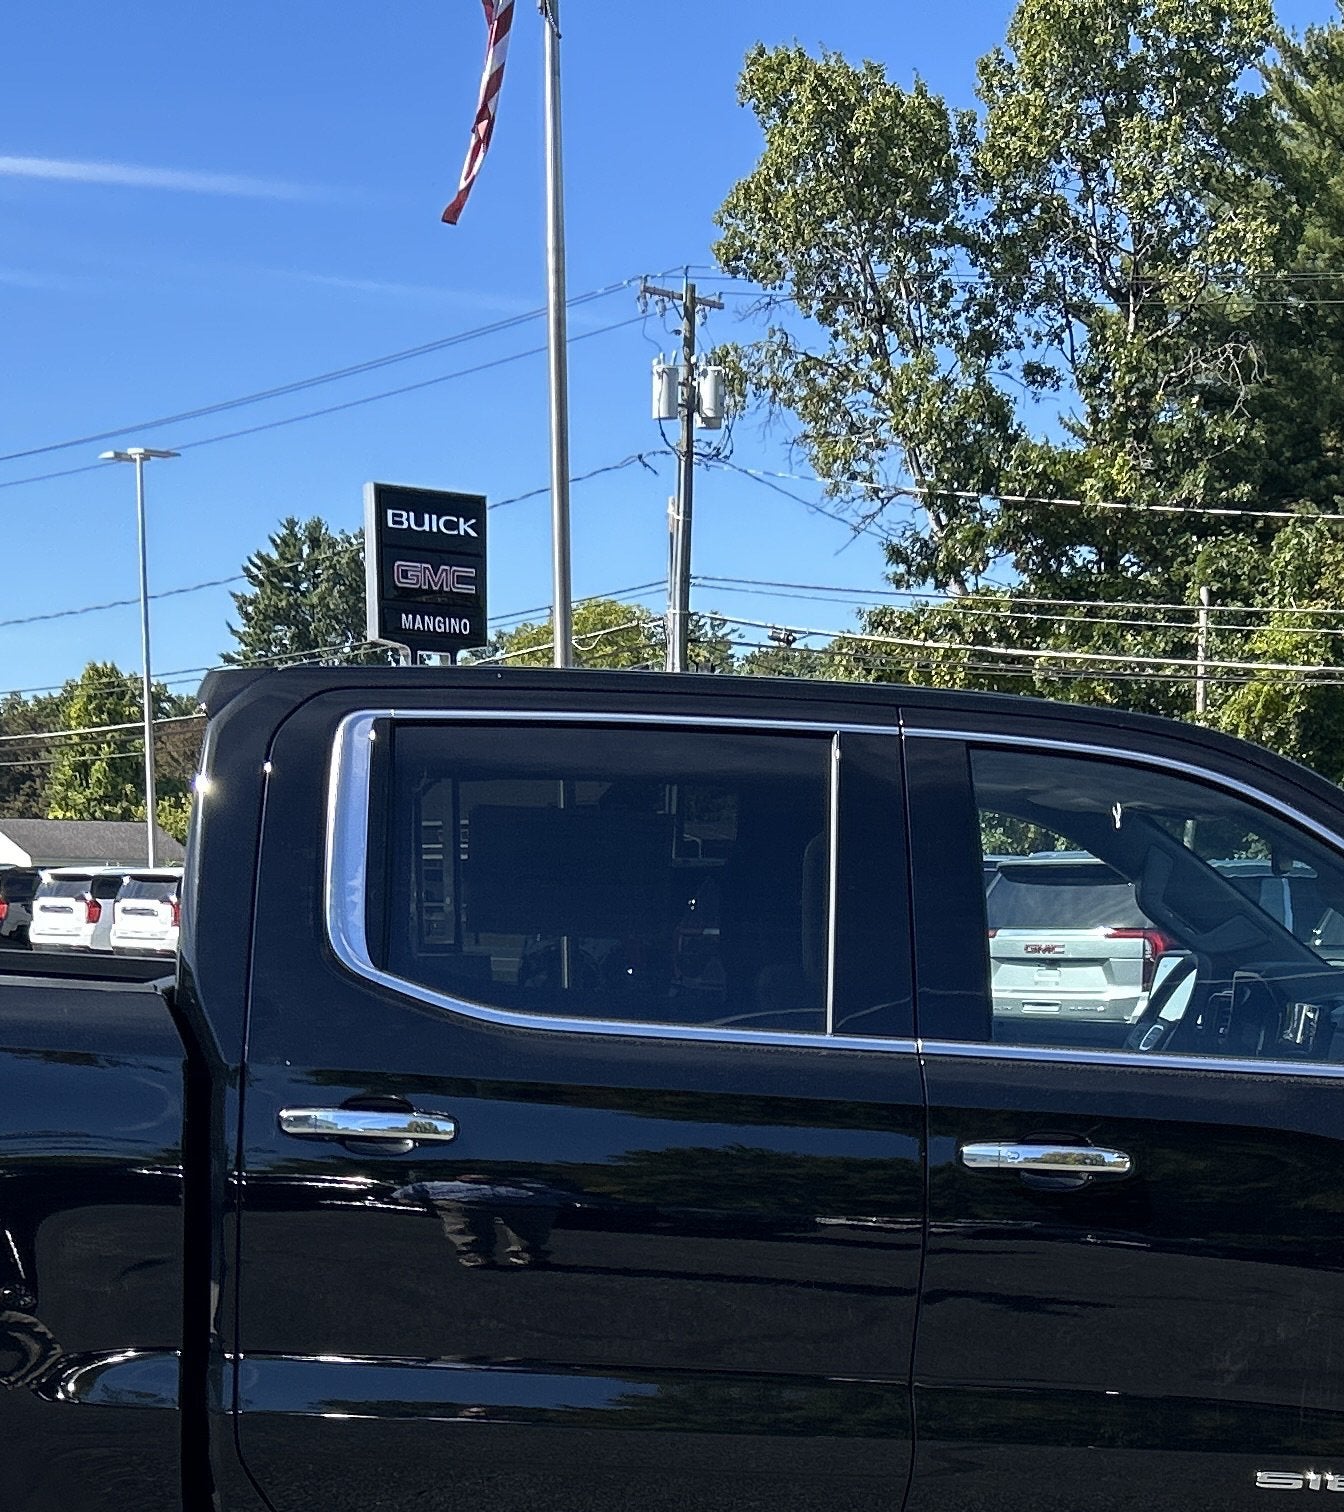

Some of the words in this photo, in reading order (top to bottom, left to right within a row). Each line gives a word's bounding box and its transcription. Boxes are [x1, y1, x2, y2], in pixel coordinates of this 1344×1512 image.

[386, 508, 479, 537] BUICK
[393, 560, 476, 595] GMC
[401, 612, 471, 635] MANGINO
[1023, 943, 1066, 955] GMC
